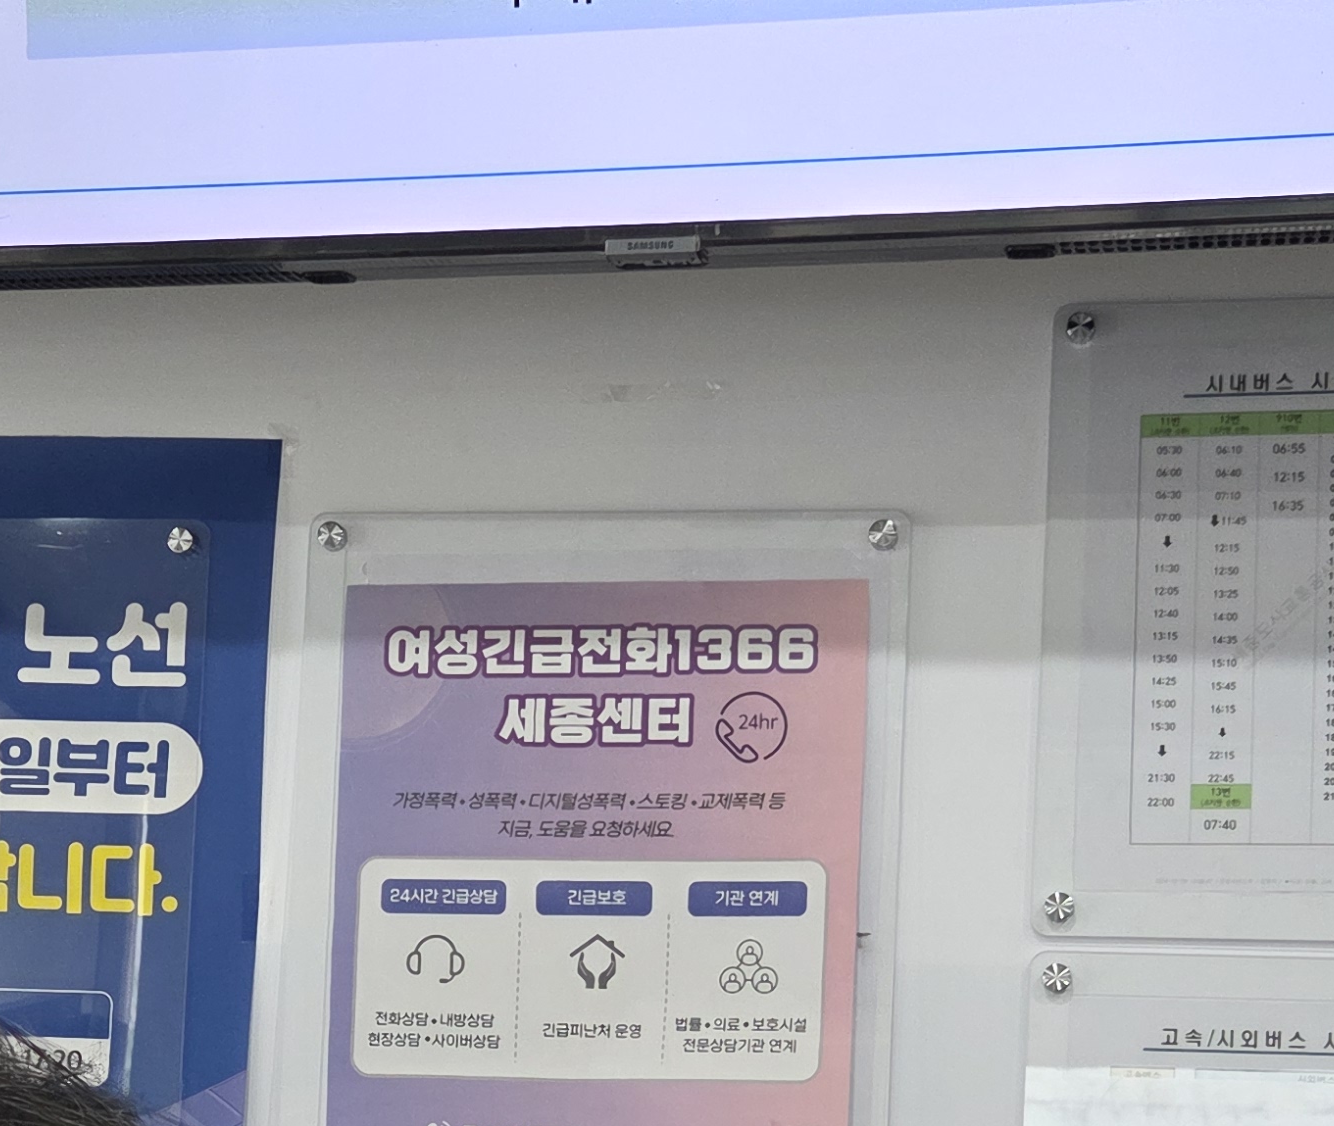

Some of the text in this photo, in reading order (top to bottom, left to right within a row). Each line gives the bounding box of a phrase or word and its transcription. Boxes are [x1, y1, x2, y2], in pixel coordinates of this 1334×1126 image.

[627, 240, 674, 251] SAMSUNG
[1205, 372, 1293, 393] 시내버스
[1272, 442, 1307, 455] 06:55
[1273, 470, 1306, 483] 12:15
[1272, 499, 1305, 512] 16:35
[16, 601, 188, 688] 노선
[385, 625, 819, 678] 여성긴급전화1366
[497, 693, 694, 747] 세종센터
[738, 712, 779, 730] 24hr
[497, 819, 533, 840] 지금,
[536, 820, 588, 839] 도움을
[1203, 819, 1237, 831] 07:40
[389, 888, 499, 905] 24시간 긴급상담
[567, 889, 627, 906] 긴급보호
[715, 890, 779, 907] 기관 연계
[542, 1022, 642, 1039] 긴급피난처 운영
[1160, 1027, 1306, 1050] 고속/시외버스
[682, 1038, 797, 1054] 전문상담기관 연계
